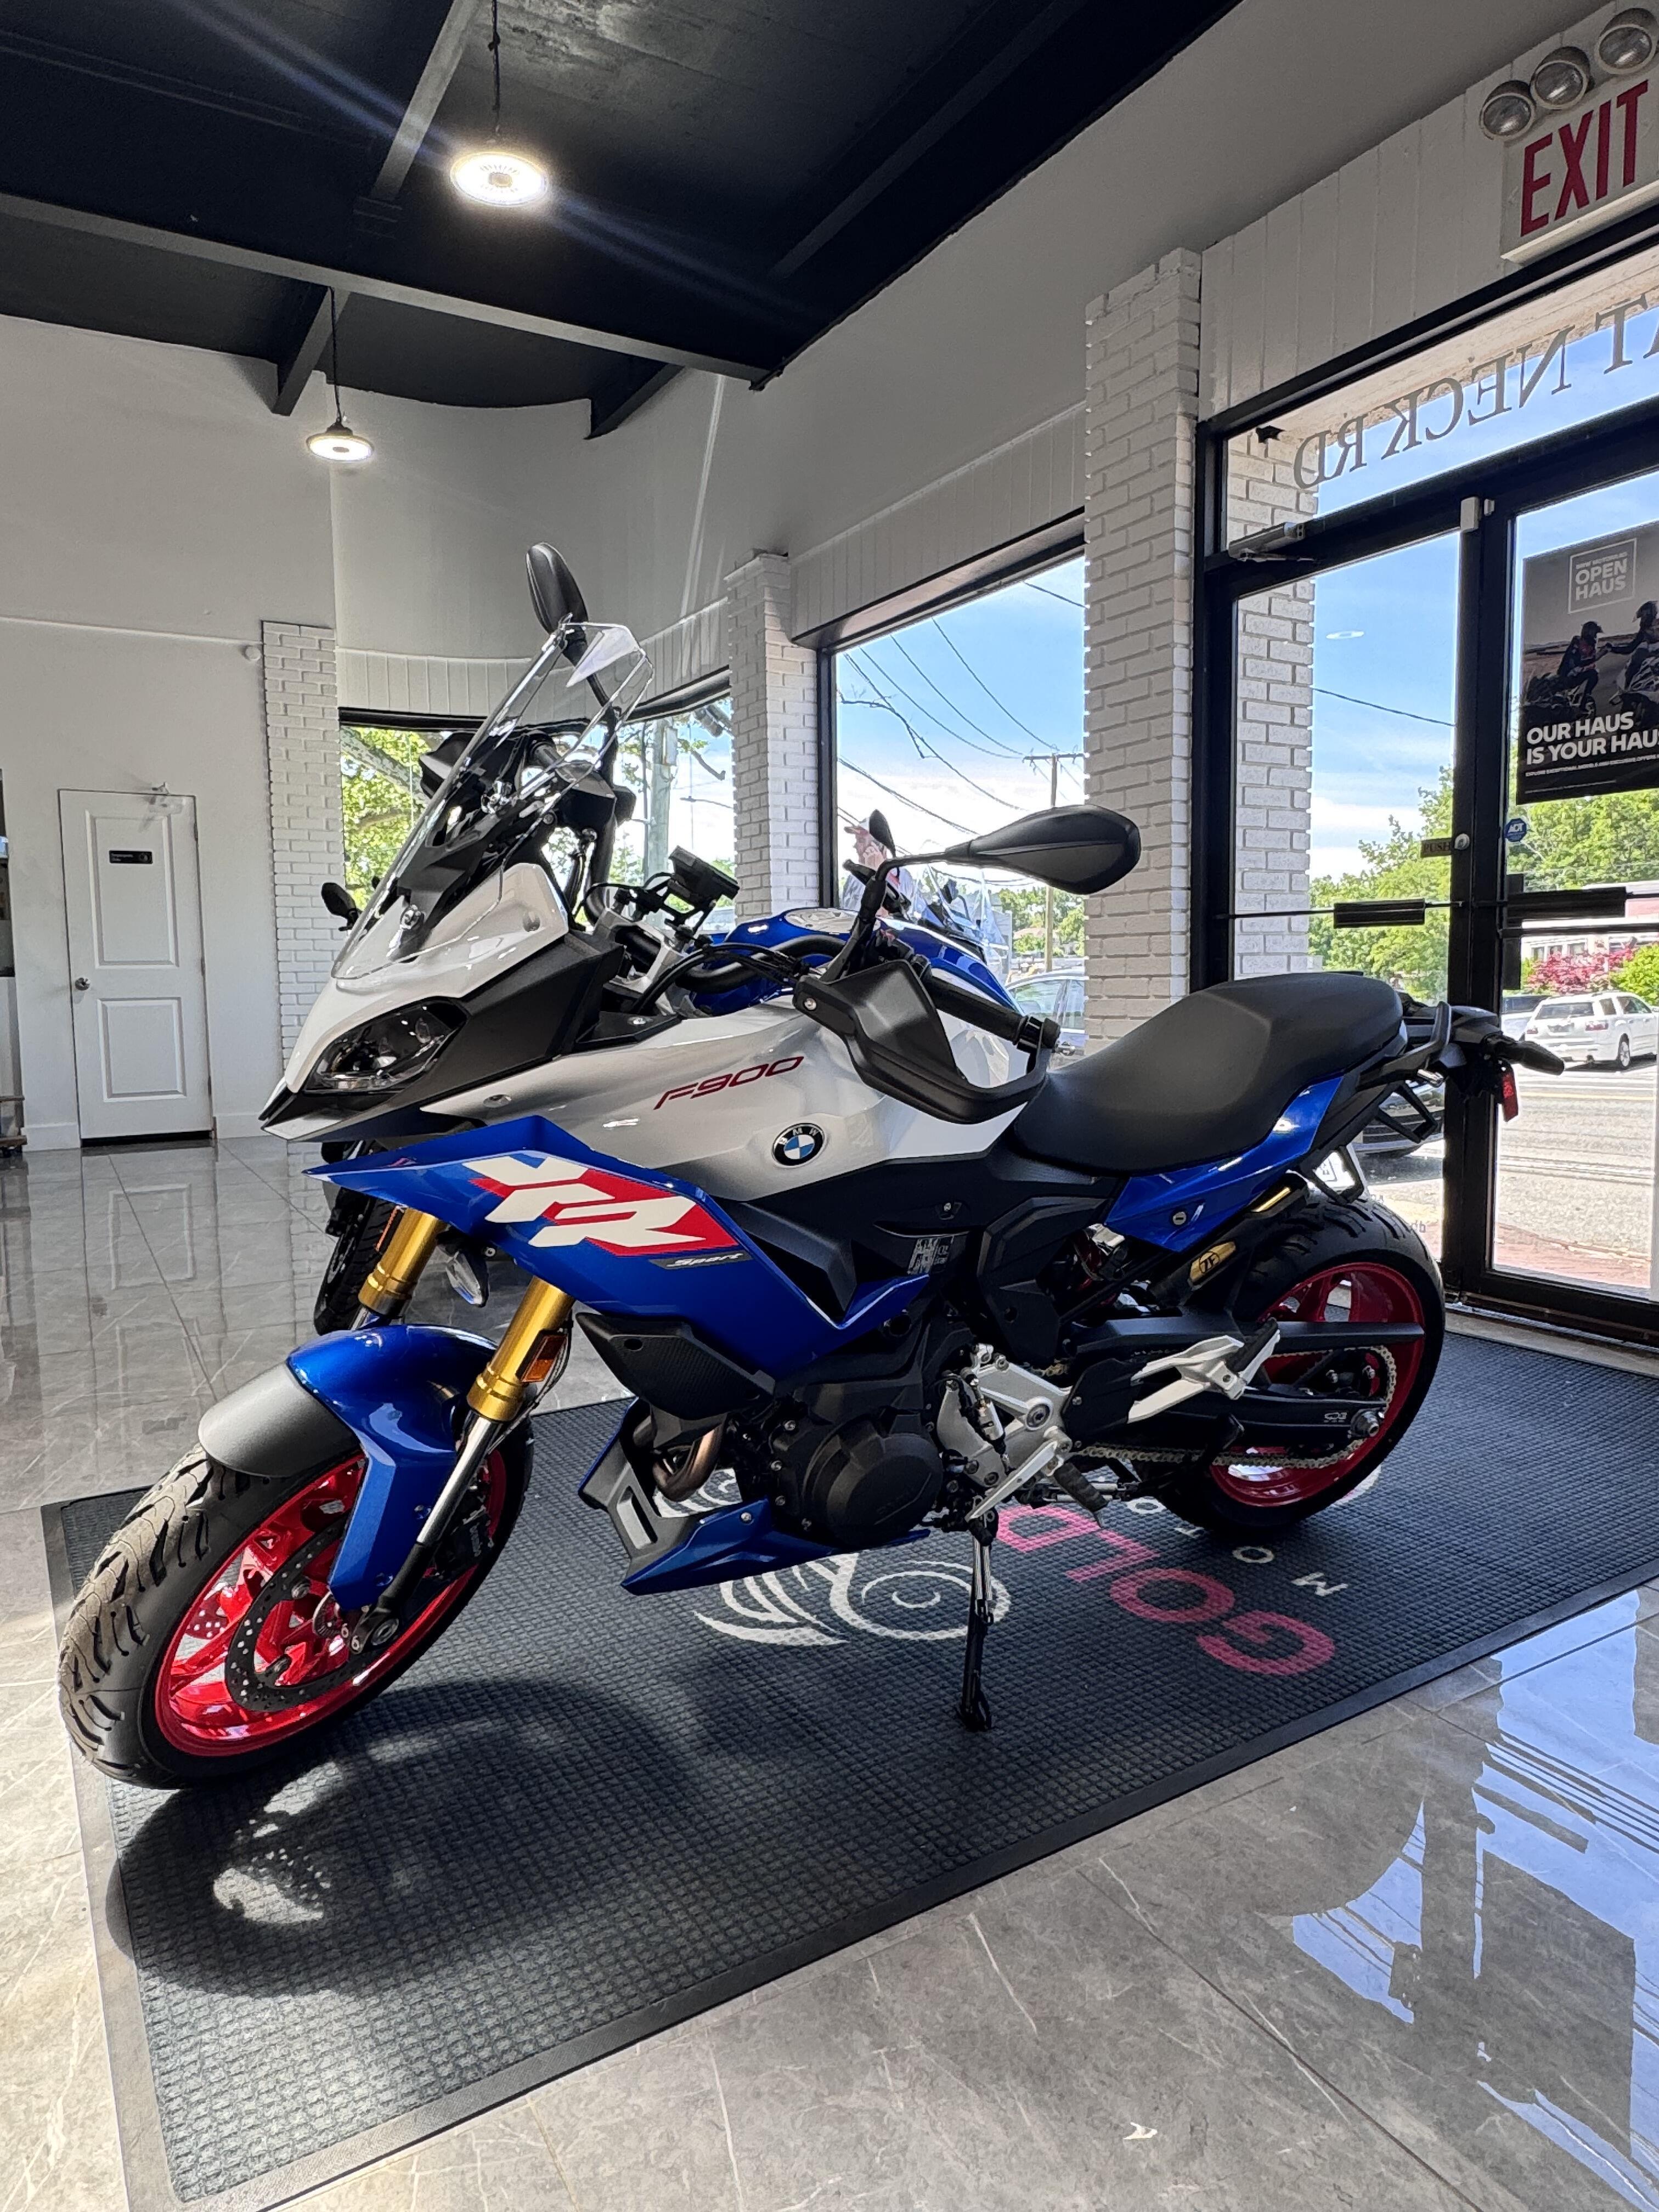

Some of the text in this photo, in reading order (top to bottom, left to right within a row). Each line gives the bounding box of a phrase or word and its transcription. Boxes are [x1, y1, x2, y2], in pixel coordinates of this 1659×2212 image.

[1520, 80, 1649, 237] EXIT
[1575, 558, 1628, 585] OPEN
[1576, 575, 1626, 601] HAUS
[1526, 711, 1634, 744] OUR HAUS
[1526, 729, 1659, 765] IS YOUR HAU
[777, 1126, 820, 1146] BMW
[462, 1155, 707, 1248] XR
[667, 1252, 743, 1268] Sport
[997, 1505, 1335, 1675] GOLD
